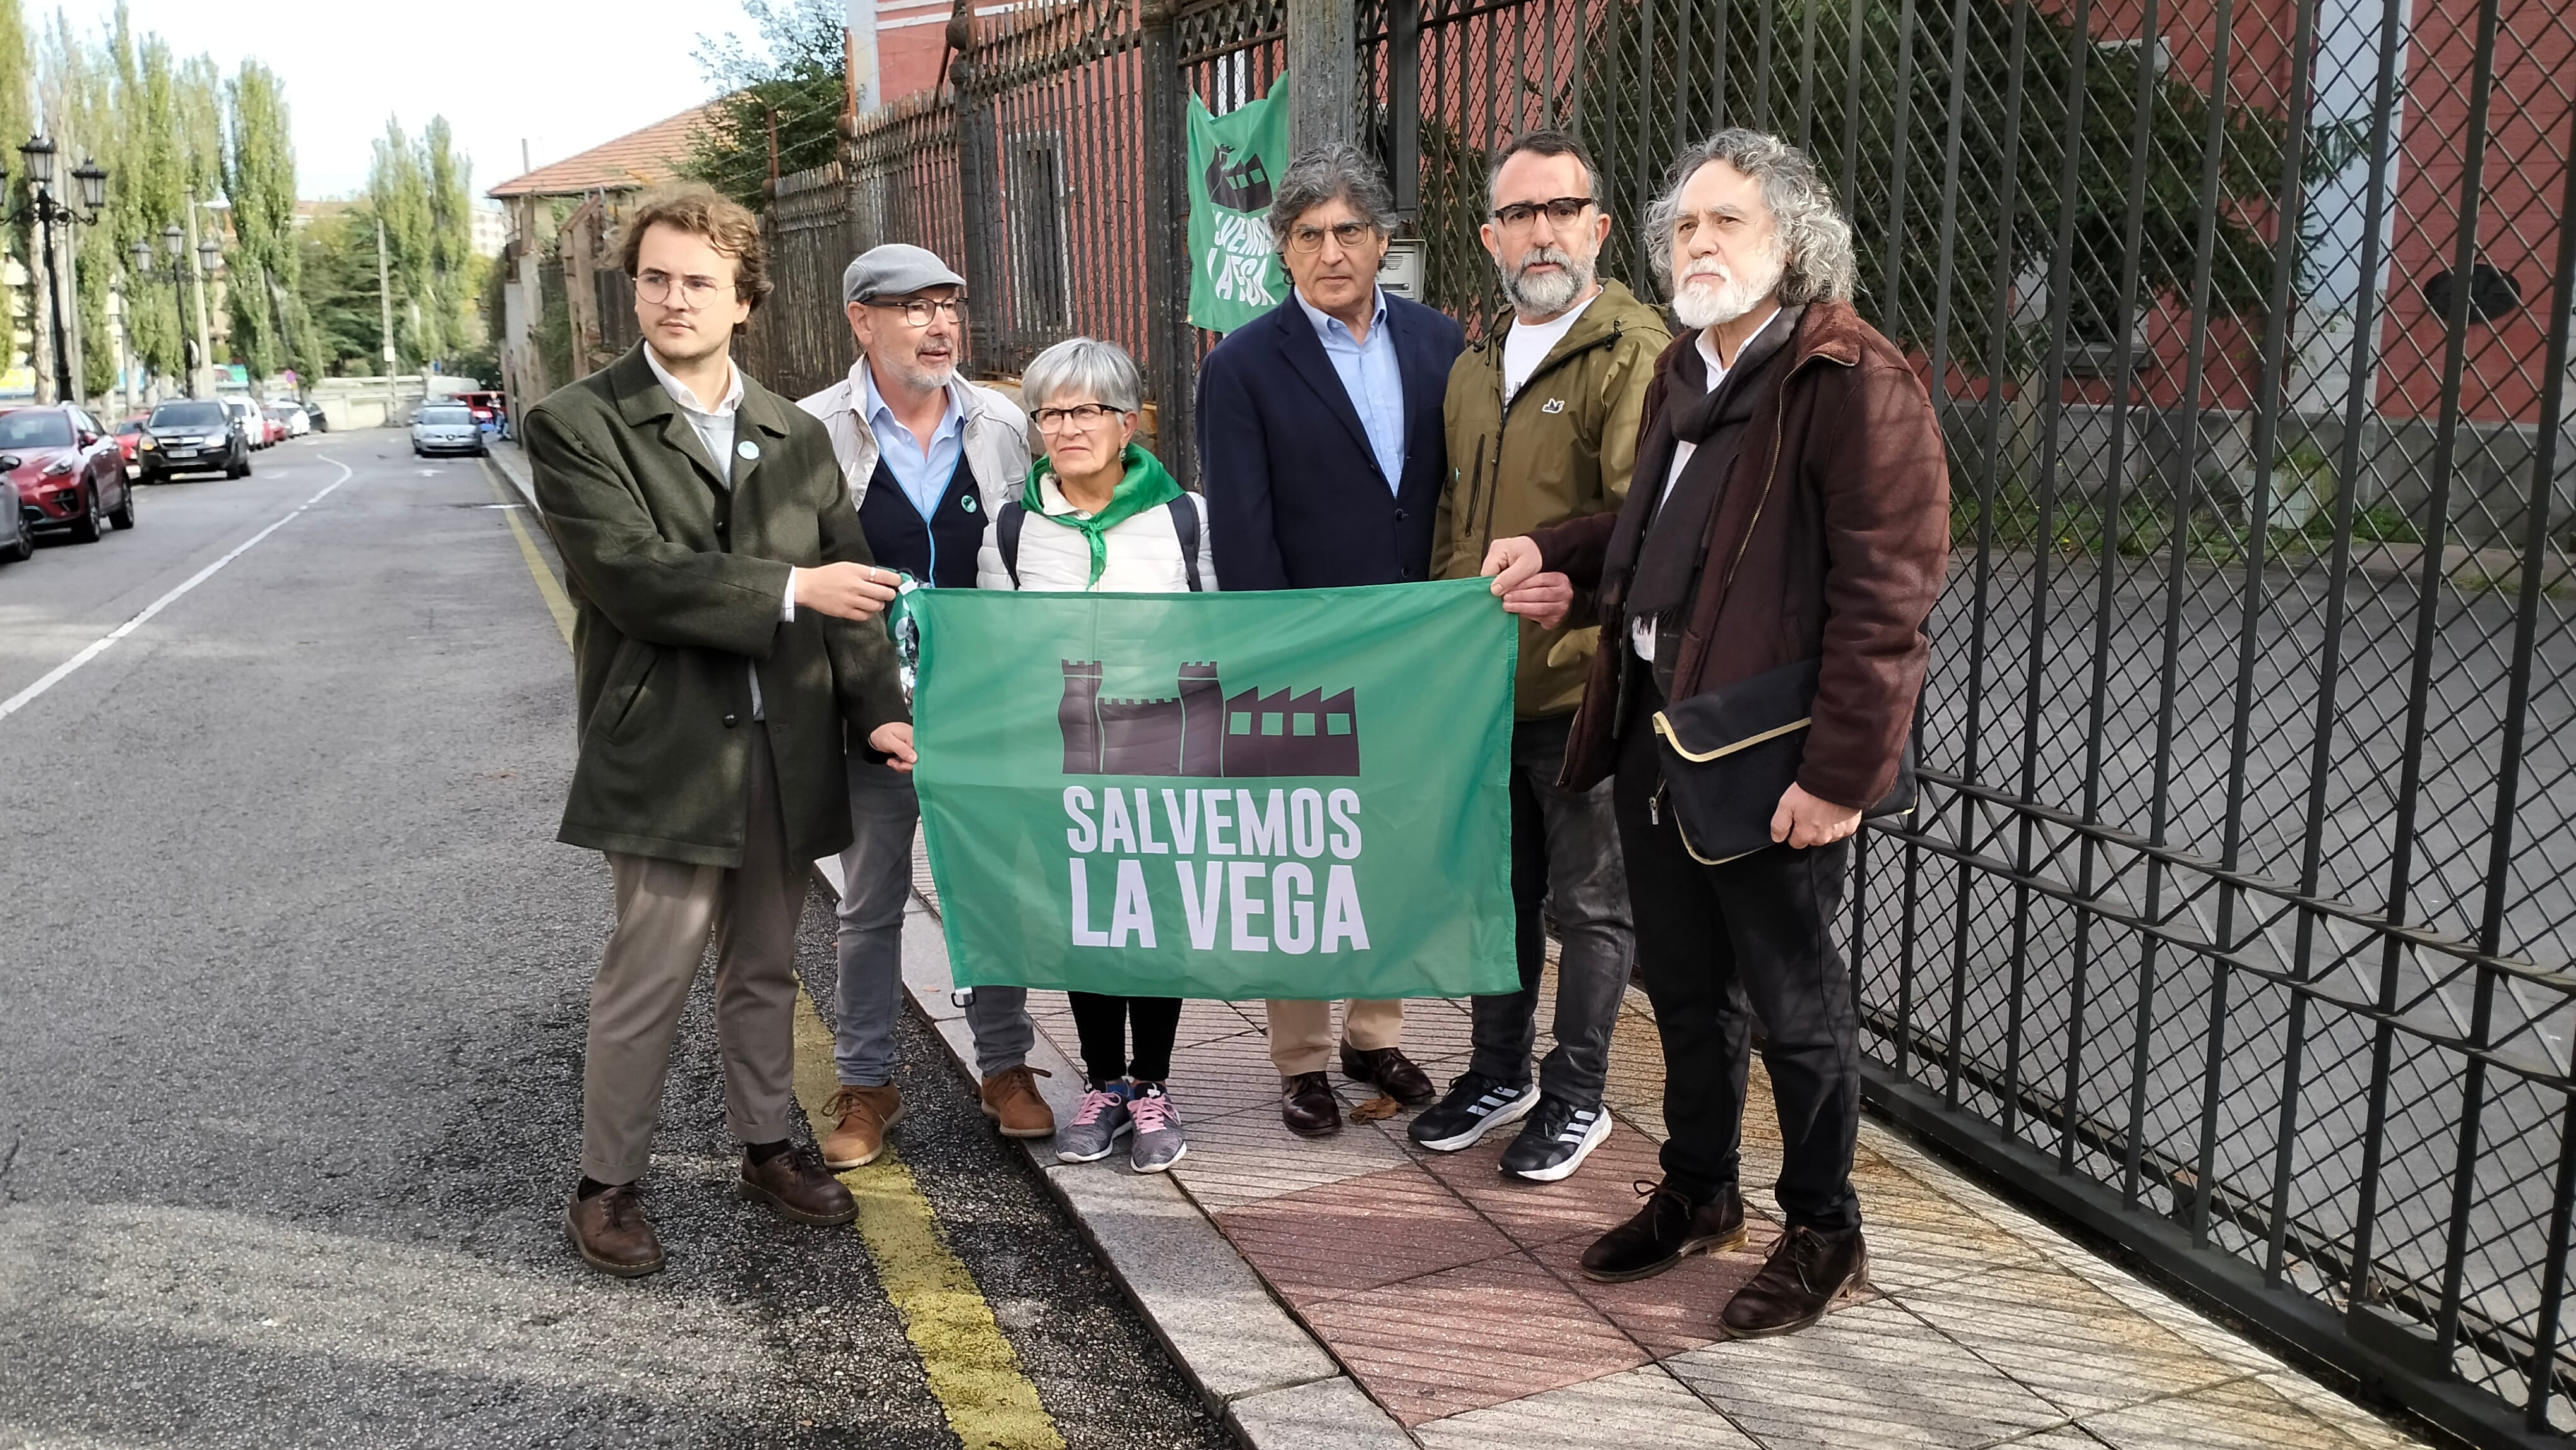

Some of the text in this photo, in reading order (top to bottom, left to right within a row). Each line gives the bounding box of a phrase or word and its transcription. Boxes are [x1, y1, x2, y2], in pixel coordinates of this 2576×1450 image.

[1063, 785, 1362, 860] SALVEMOS
[1069, 857, 1371, 955] LA VEGA
